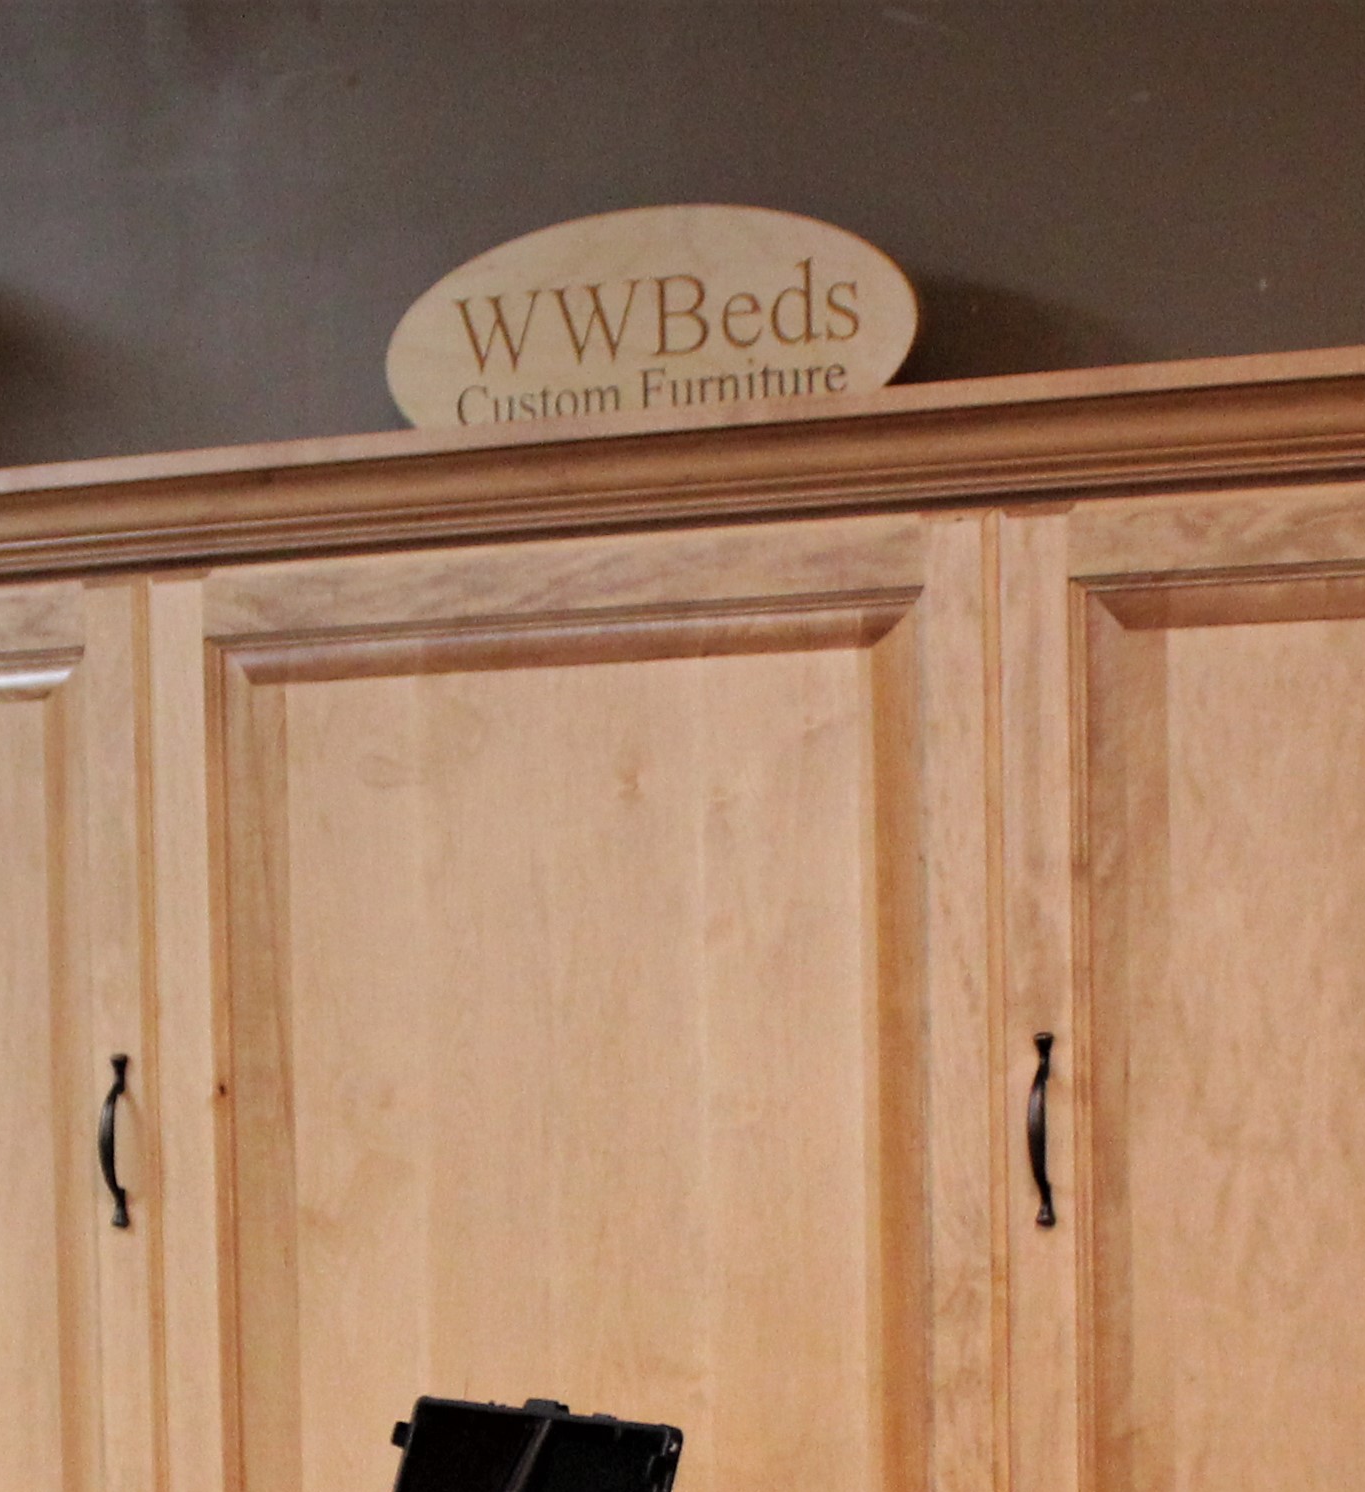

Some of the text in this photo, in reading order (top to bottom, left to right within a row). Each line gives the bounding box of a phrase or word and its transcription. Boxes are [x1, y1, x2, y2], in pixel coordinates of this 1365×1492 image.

[453, 256, 861, 376] WWBeds
[456, 357, 849, 427] Custom Furniture
